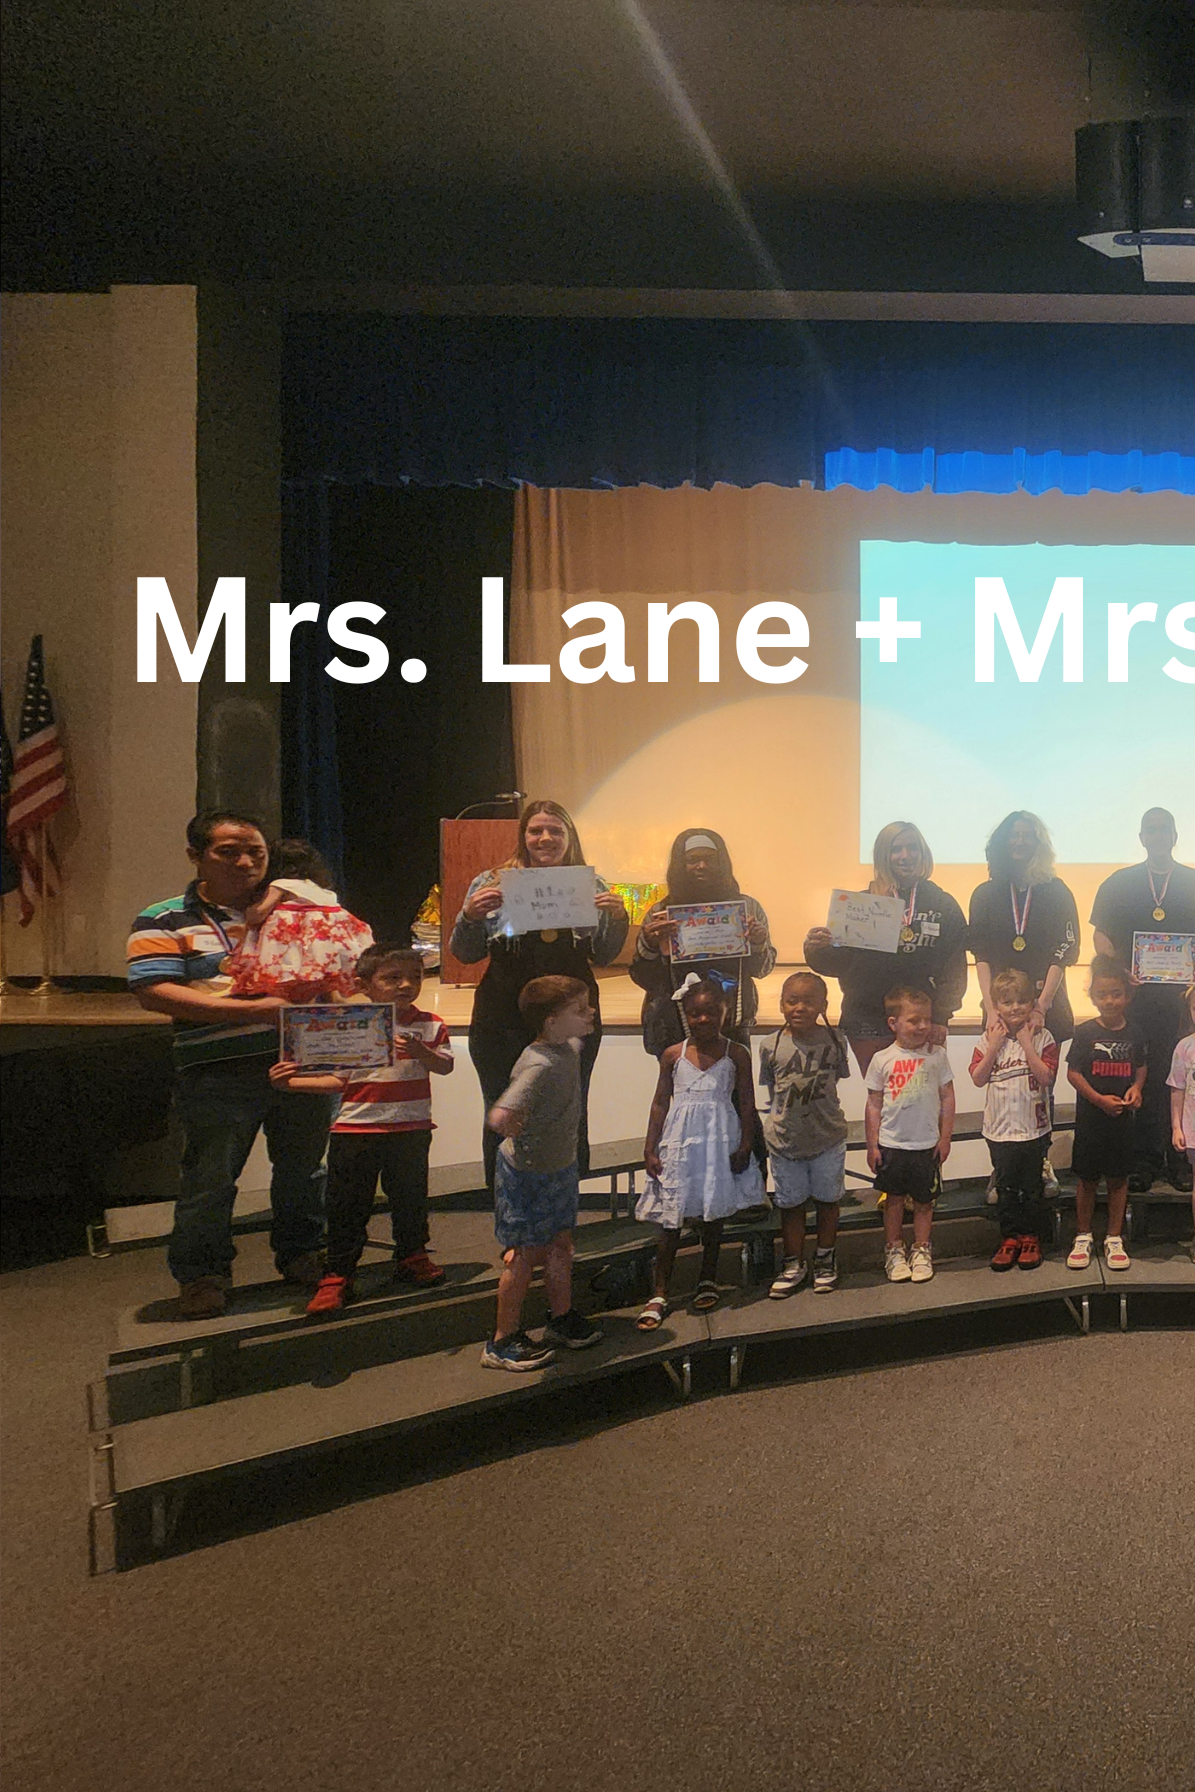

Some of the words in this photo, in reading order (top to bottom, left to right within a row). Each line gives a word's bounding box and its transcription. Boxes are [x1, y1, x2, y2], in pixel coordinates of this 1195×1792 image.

[685, 914, 731, 927] Award
[1147, 942, 1183, 953] Award
[305, 1017, 369, 1032] Award
[1092, 1061, 1132, 1077] PUMA
